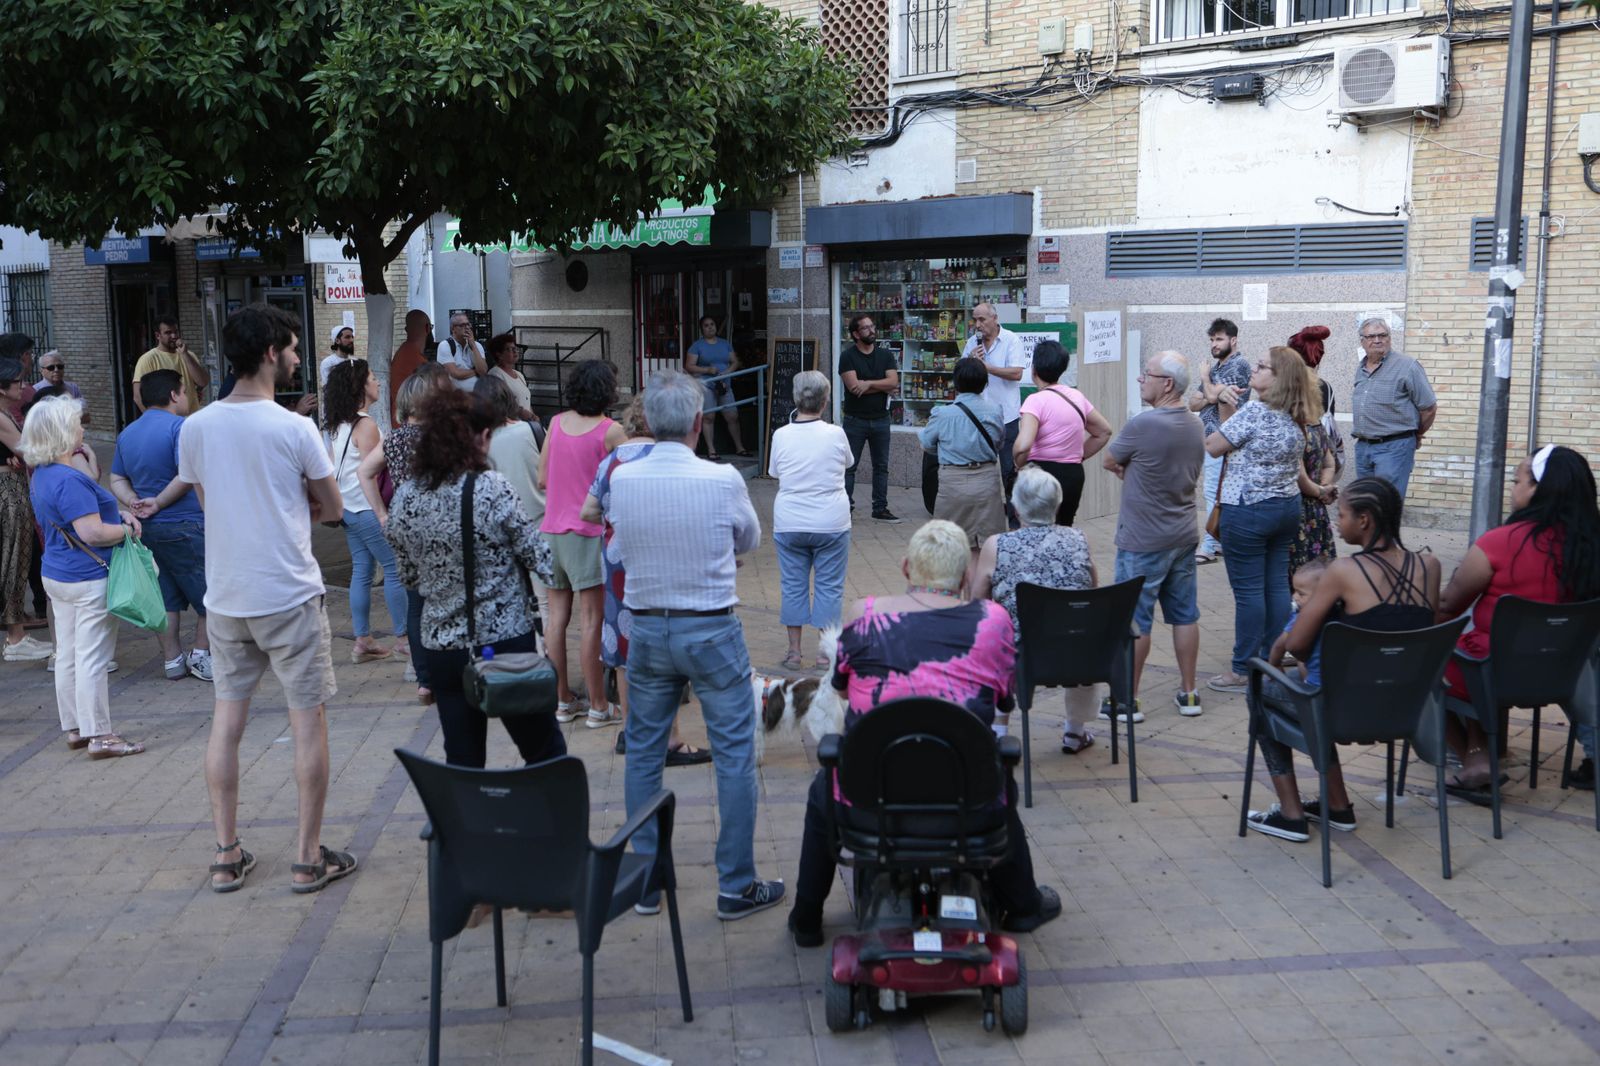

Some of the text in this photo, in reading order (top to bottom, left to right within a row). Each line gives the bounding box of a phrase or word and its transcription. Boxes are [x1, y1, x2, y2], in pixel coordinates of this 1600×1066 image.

[651, 229, 689, 240] LATINOS
[105, 250, 128, 262] PEDRO
[328, 265, 338, 274] Pan
[337, 274, 345, 282] de
[328, 287, 365, 299] POLVILL
